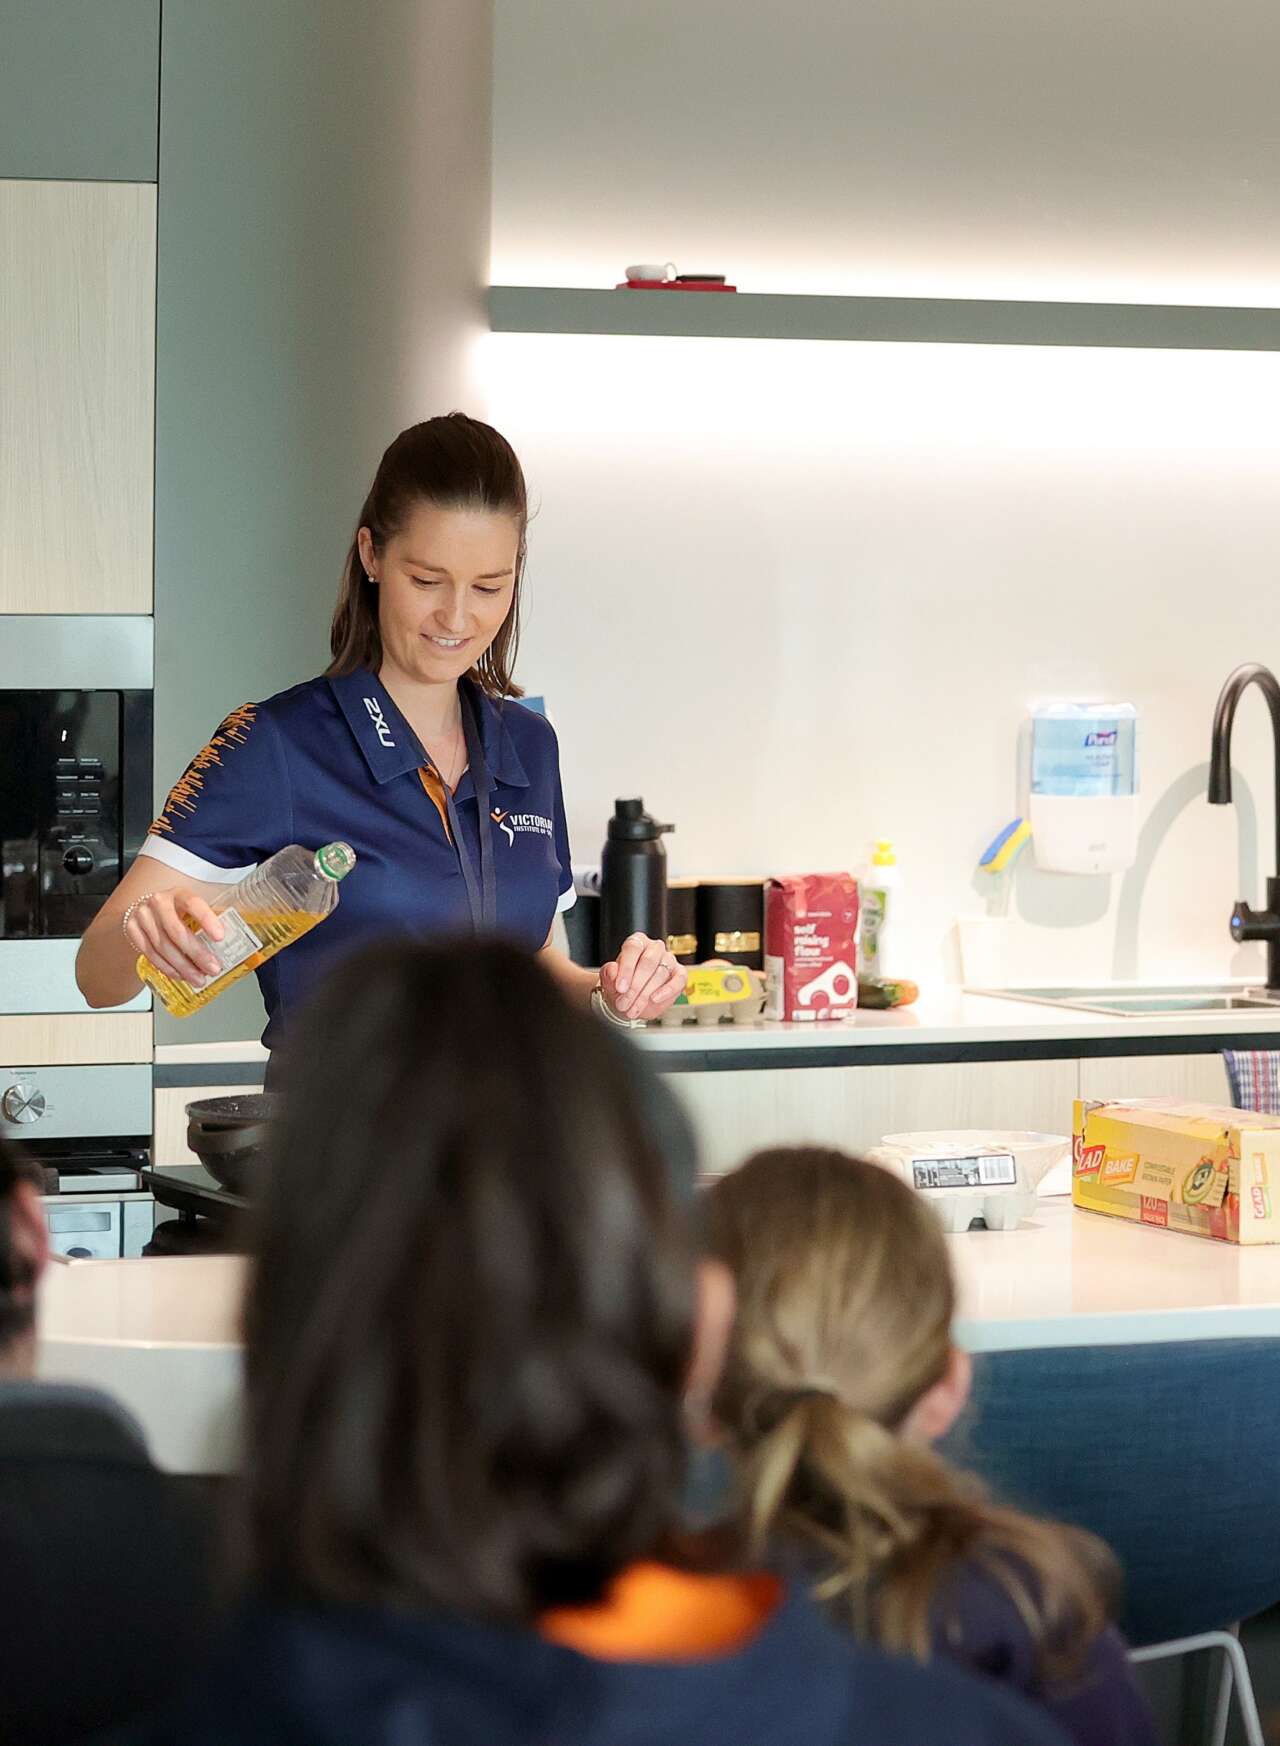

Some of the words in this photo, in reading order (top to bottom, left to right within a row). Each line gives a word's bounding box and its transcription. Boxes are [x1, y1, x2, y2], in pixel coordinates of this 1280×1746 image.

[362, 697, 395, 747] 2XU
[1104, 1158, 1135, 1175] BAKE
[1252, 1187, 1265, 1218] GLAD
